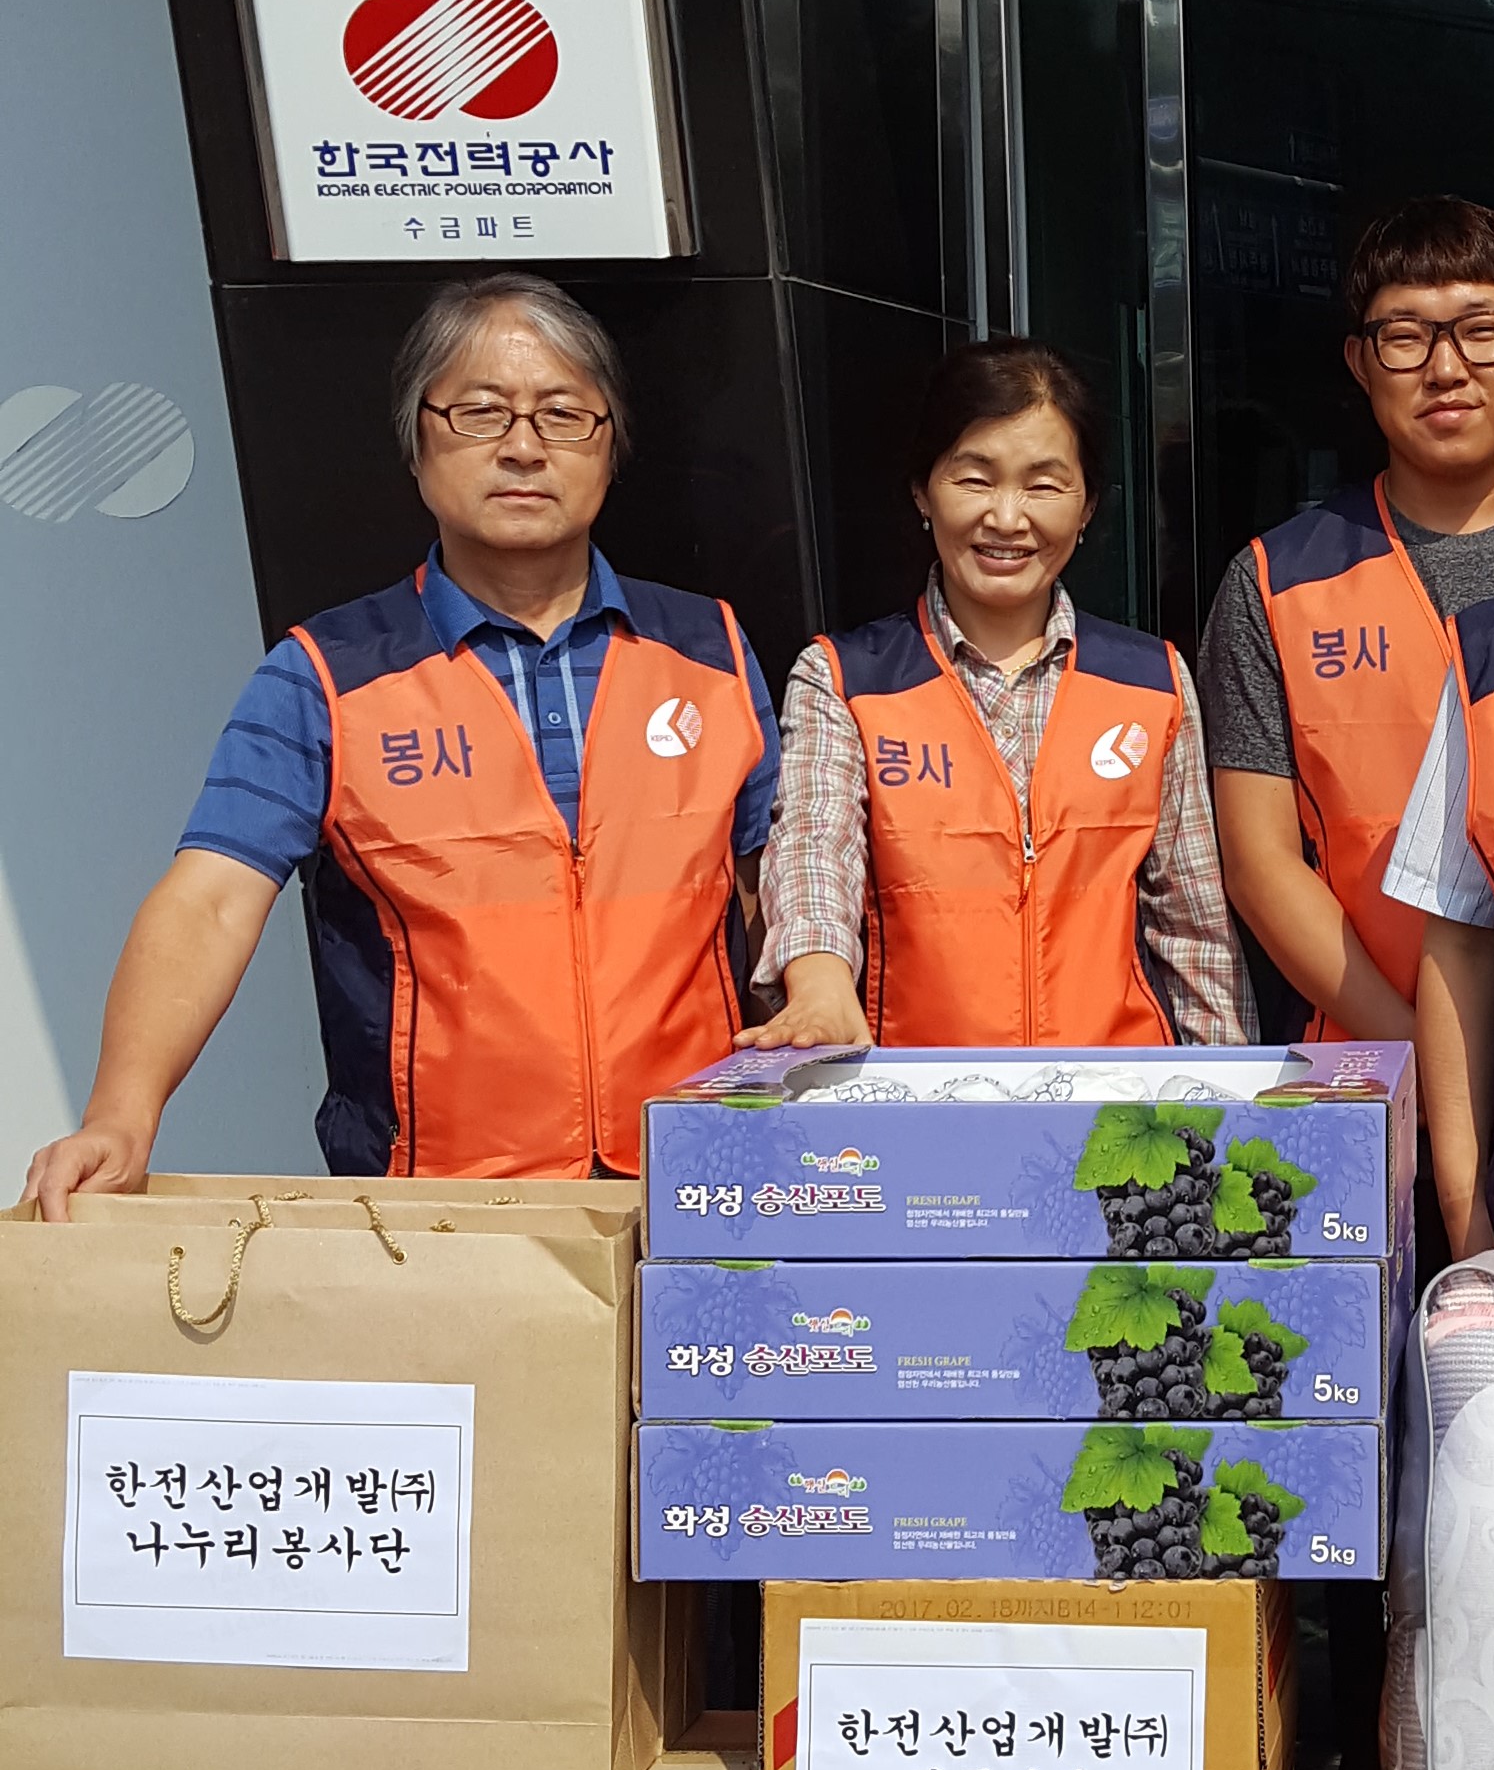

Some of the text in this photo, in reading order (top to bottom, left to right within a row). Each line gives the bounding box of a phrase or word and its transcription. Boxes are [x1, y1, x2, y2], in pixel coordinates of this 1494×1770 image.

[312, 138, 614, 178] 한국전력공사
[316, 181, 614, 198] KOREA ELECTRIC POWER CORPORATION
[403, 215, 535, 240] 수금파트
[1311, 625, 1391, 679] 봉사
[380, 724, 475, 787] 봉사
[874, 734, 954, 789] 봉사
[675, 1183, 887, 1217] 화성 송산포도
[906, 1195, 981, 1206] FRESH GRAPE
[1321, 1211, 1369, 1243] 5kg
[667, 1343, 878, 1378] 화성 송산포도
[897, 1355, 971, 1367] FRESH GRAPE
[1313, 1374, 1360, 1405] 5kg
[105, 1459, 437, 1516] 한전산업개발(주)
[663, 1504, 873, 1537] 화성 송산포도
[893, 1516, 968, 1528] FRESH GRAPE
[126, 1521, 411, 1574] 나누리 봉사단
[1309, 1535, 1356, 1566] 5kg
[836, 1708, 1169, 1759] 한전산업개발(주)
